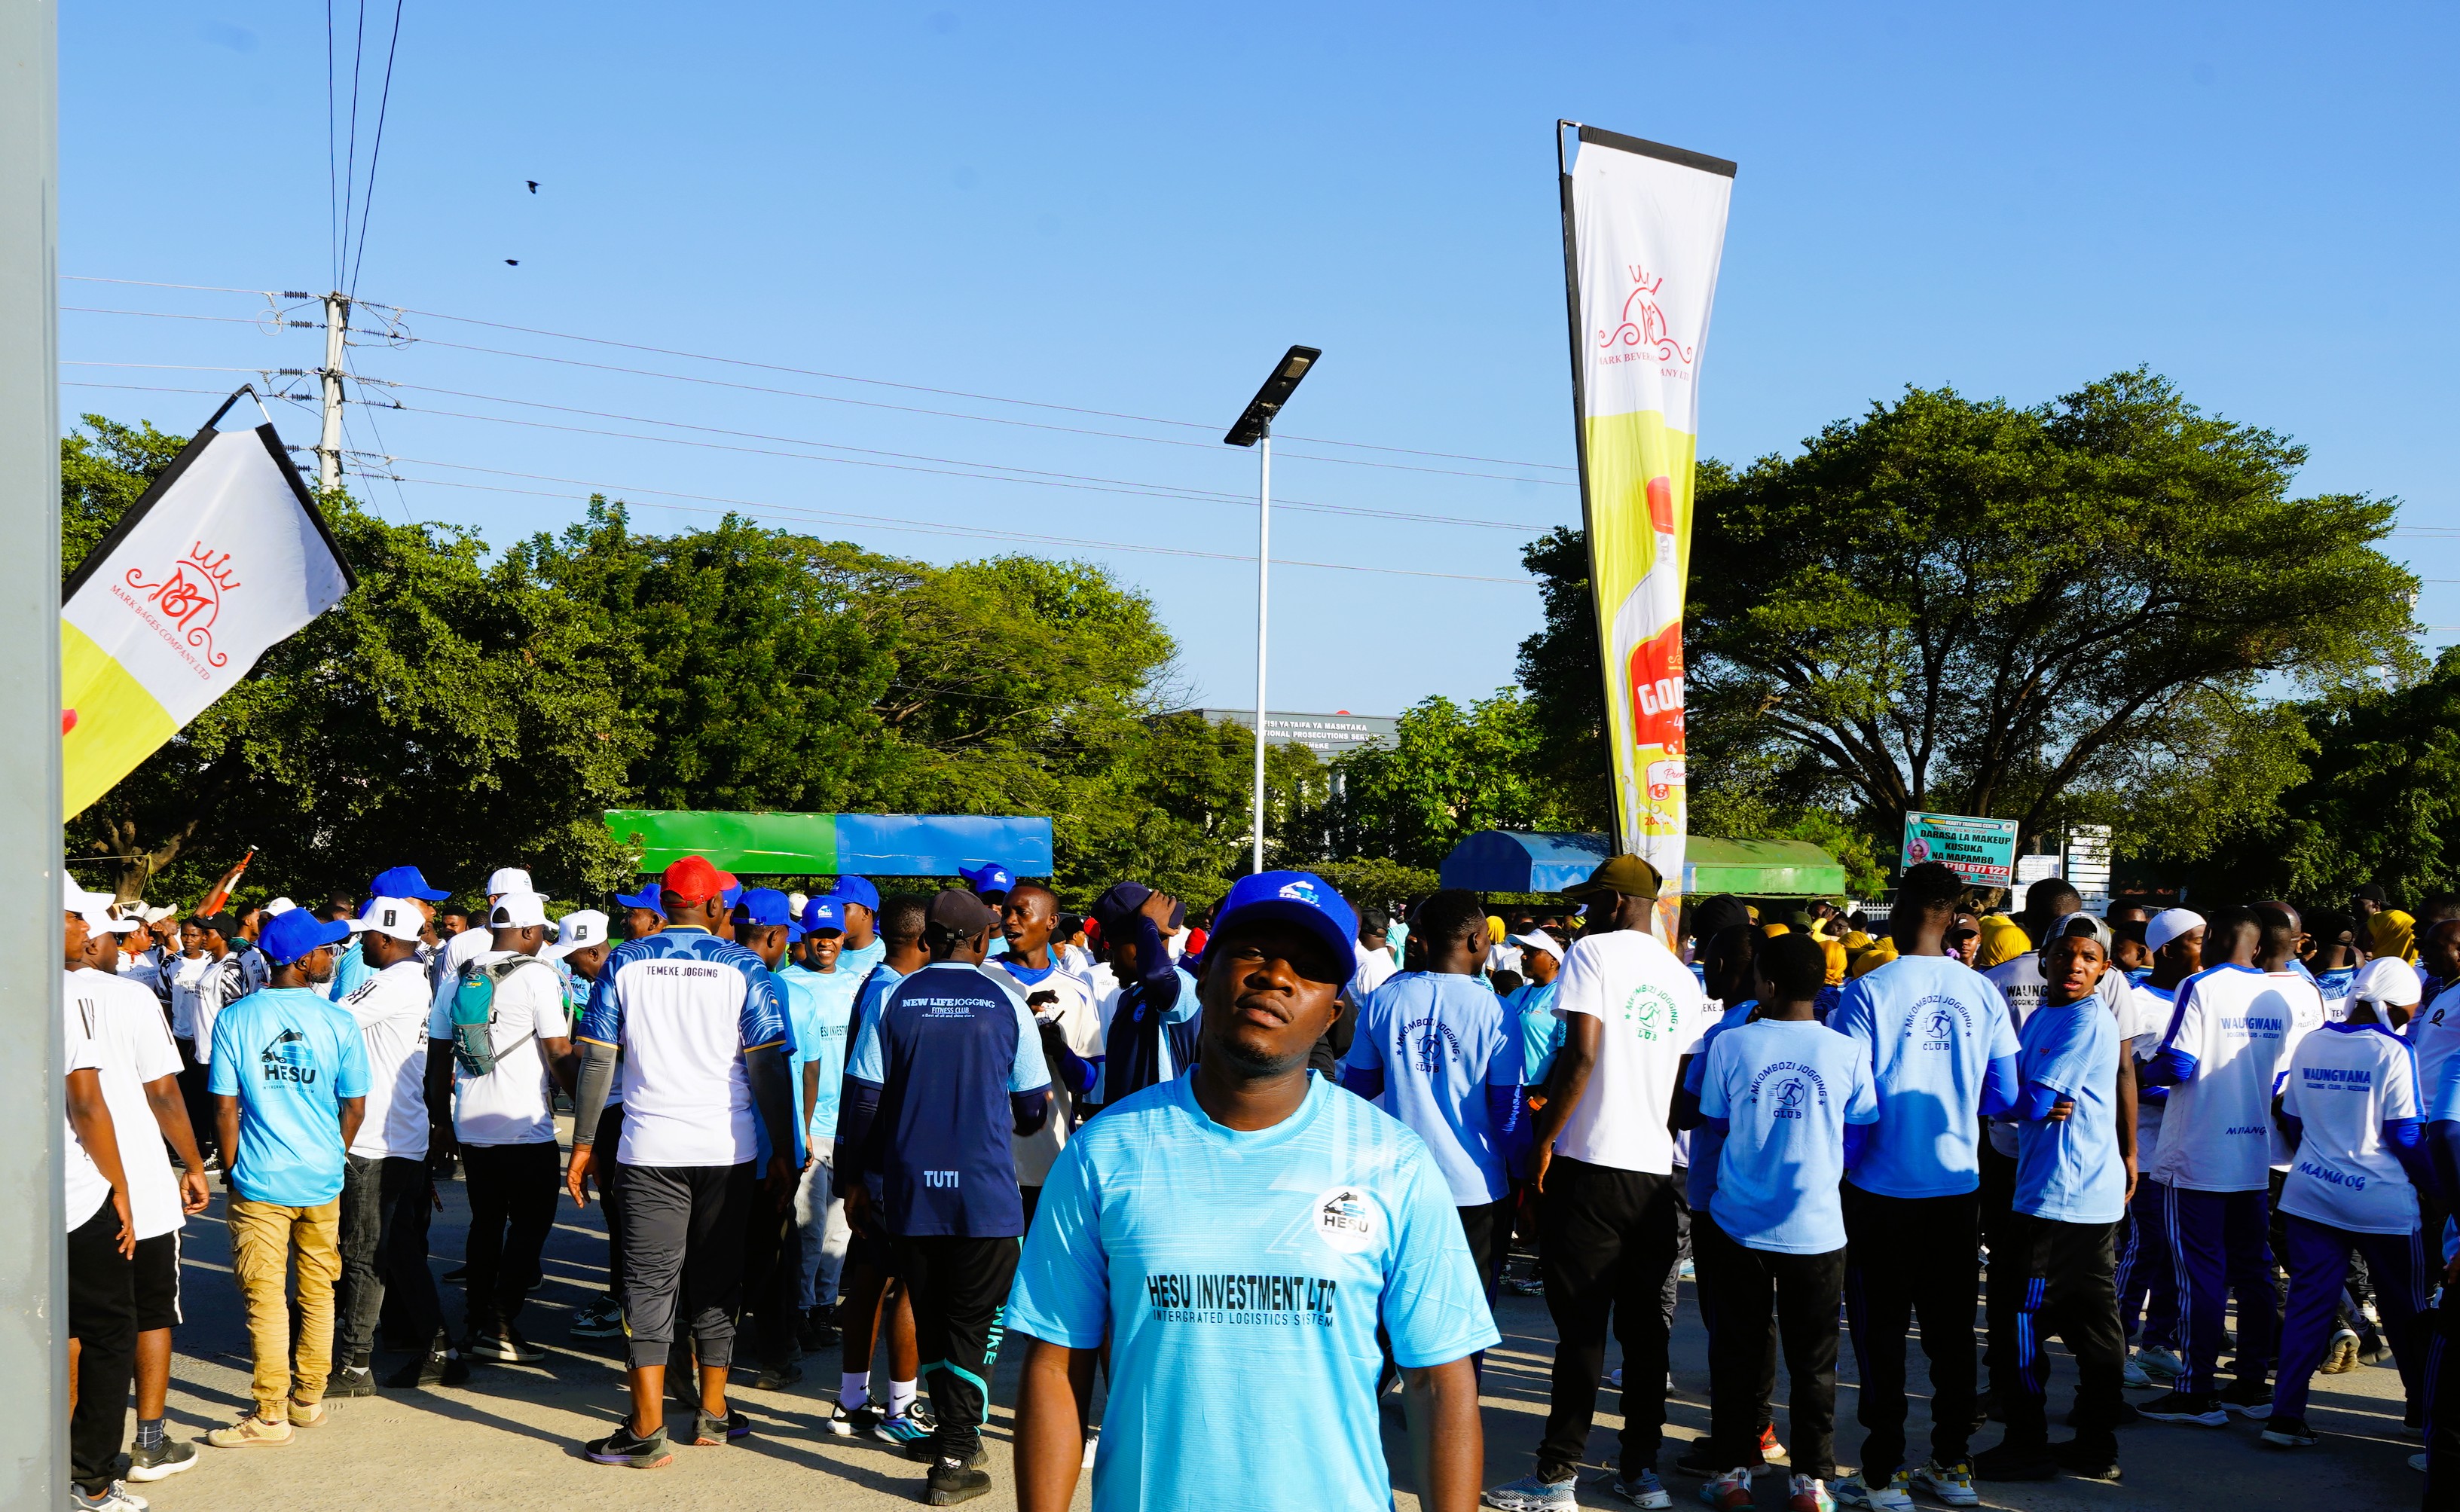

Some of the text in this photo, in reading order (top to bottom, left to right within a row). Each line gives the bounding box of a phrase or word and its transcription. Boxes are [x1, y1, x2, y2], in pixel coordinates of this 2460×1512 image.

[110, 585, 211, 680] MARK BAGES COMPANY LTD
[1637, 677, 1684, 716] GOO
[1294, 731, 1348, 740] PROSECUTIONS
[1325, 722, 1367, 732] MASHTAKA
[1921, 829, 2011, 845] DARASA LA MAKEUP
[1945, 842, 1983, 854] KUSUKA
[1932, 851, 1994, 865] NA MAPAMBO
[1968, 864, 1987, 873] 677
[1988, 866, 2008, 875] 122
[646, 966, 718, 978] TEMEKE JOGGING
[902, 998, 995, 1009] NEW LIFE JOGGING
[1657, 990, 1679, 1025] JOGGING
[1905, 995, 1973, 1028] MKOMBOZI JOGGING
[1396, 1018, 1460, 1055] MKOMBOZI JOGGING
[1636, 1029, 1658, 1041] LUB
[1923, 1043, 1950, 1051] CLUB
[264, 1064, 316, 1084] HESU
[1415, 1063, 1440, 1073] CLUB
[2303, 1068, 2371, 1084] WAUNGWANA
[1750, 1061, 1828, 1097] MKOMBOZI JOGGING
[1773, 1110, 1802, 1119] CLUB
[924, 1170, 959, 1188] TUTI
[2345, 1174, 2366, 1192] OG
[1324, 1214, 1369, 1233] HESU
[1146, 1274, 1336, 1314] HESU INVESTMENT LTD
[1153, 1309, 1334, 1327] INTERGRATED LOGISTICS SYSTEM
[982, 1312, 1004, 1365] NIKE
